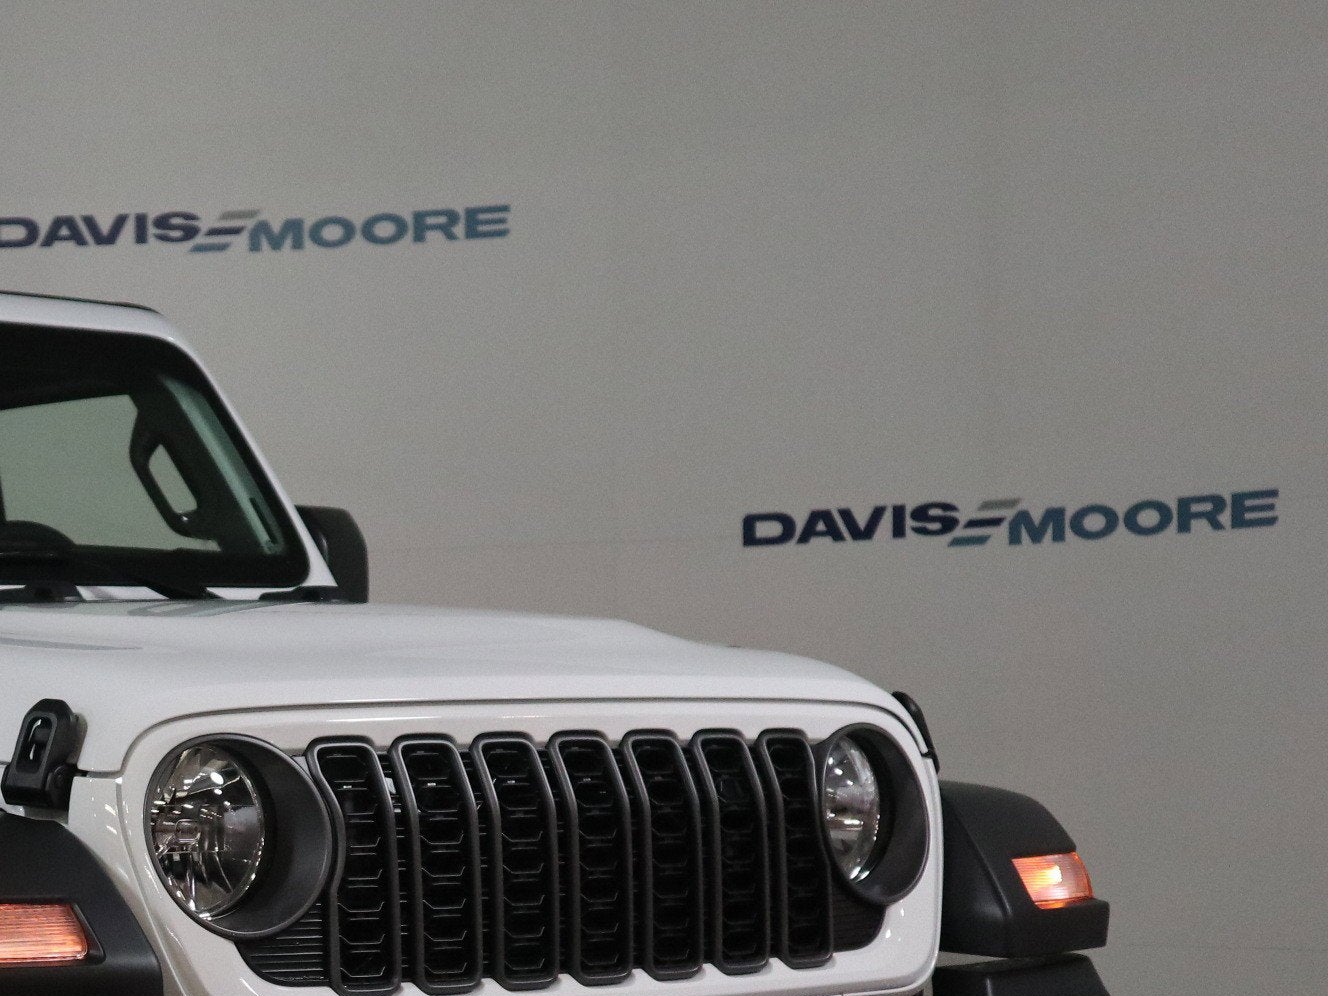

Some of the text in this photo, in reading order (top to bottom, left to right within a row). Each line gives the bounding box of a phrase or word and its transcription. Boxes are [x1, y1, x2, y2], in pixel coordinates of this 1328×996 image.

[248, 204, 512, 253] MOORE
[741, 489, 1281, 548] DAVIS MOORE
